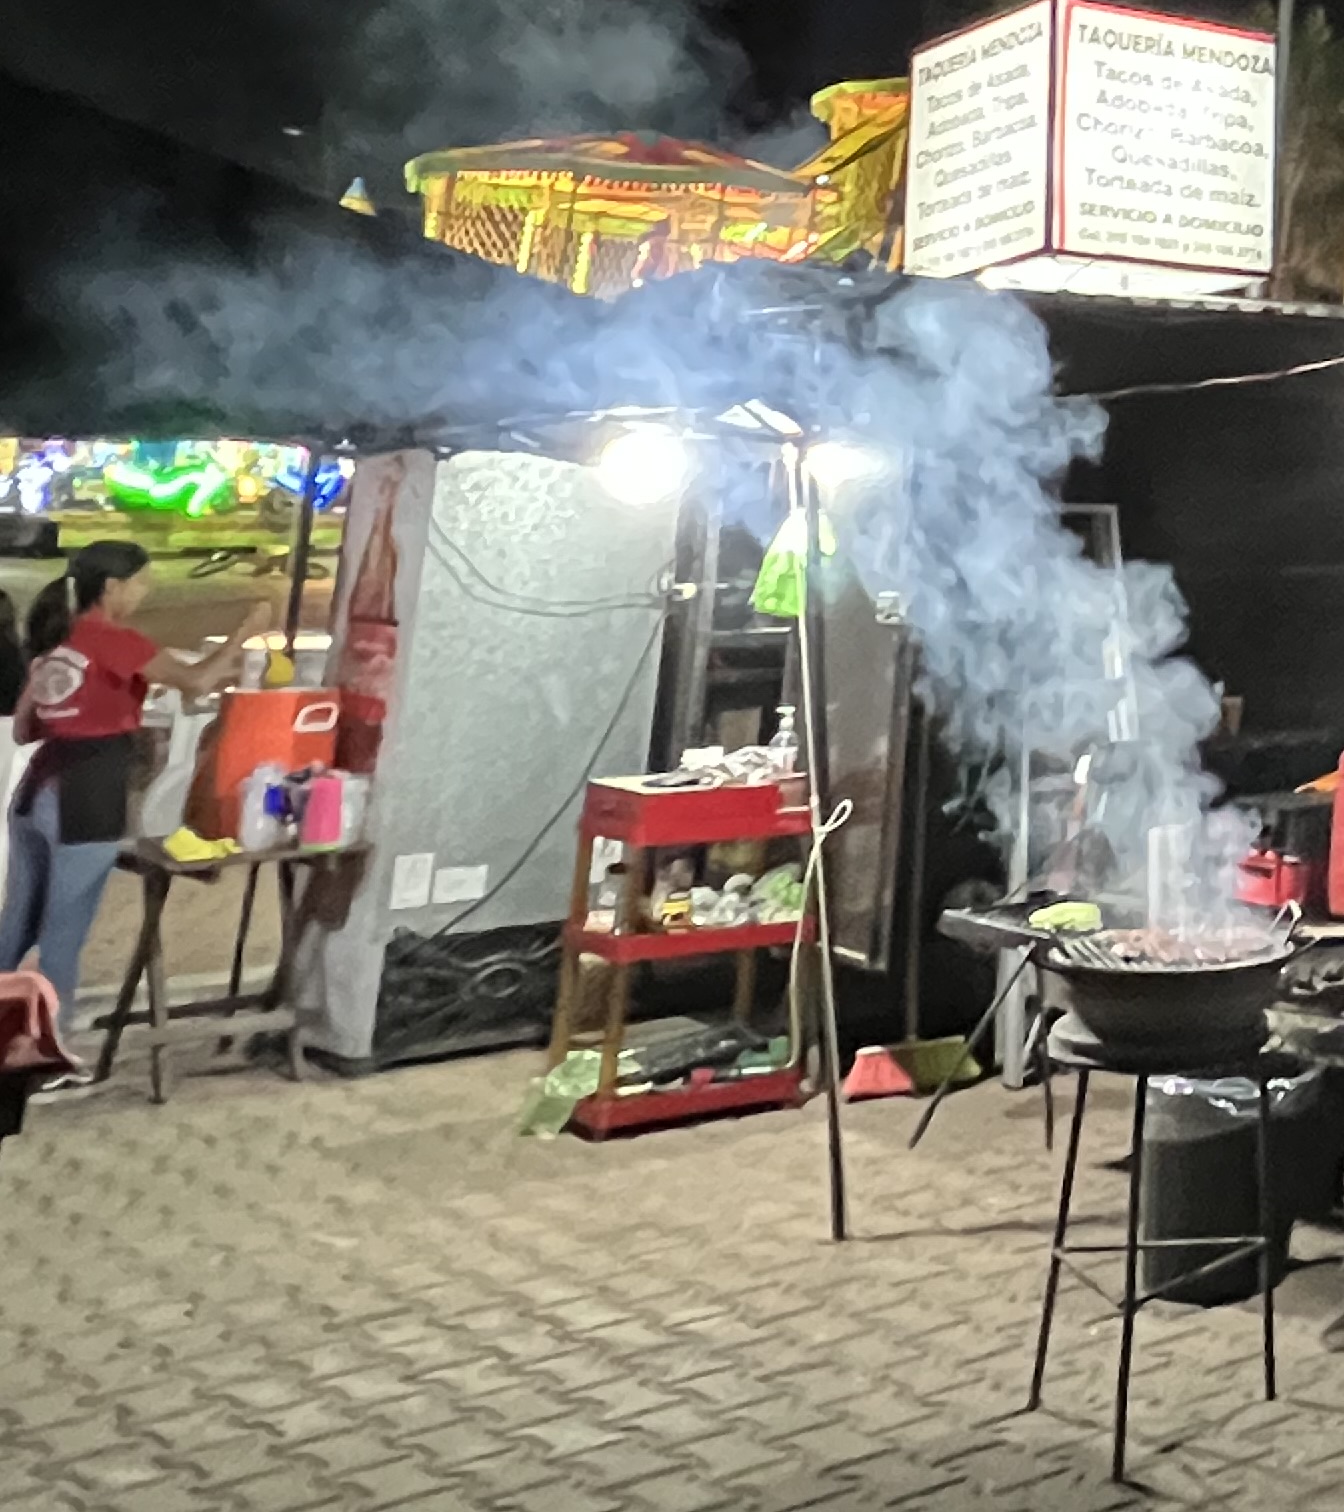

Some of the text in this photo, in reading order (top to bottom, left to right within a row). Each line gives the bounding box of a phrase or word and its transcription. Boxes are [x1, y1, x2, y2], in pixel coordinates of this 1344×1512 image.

[1078, 23, 1272, 76] TAQUERÍA MENDOZA
[1094, 60, 1154, 86] Tacos
[1079, 202, 1265, 238] SERVICIO A DOMICILIO
